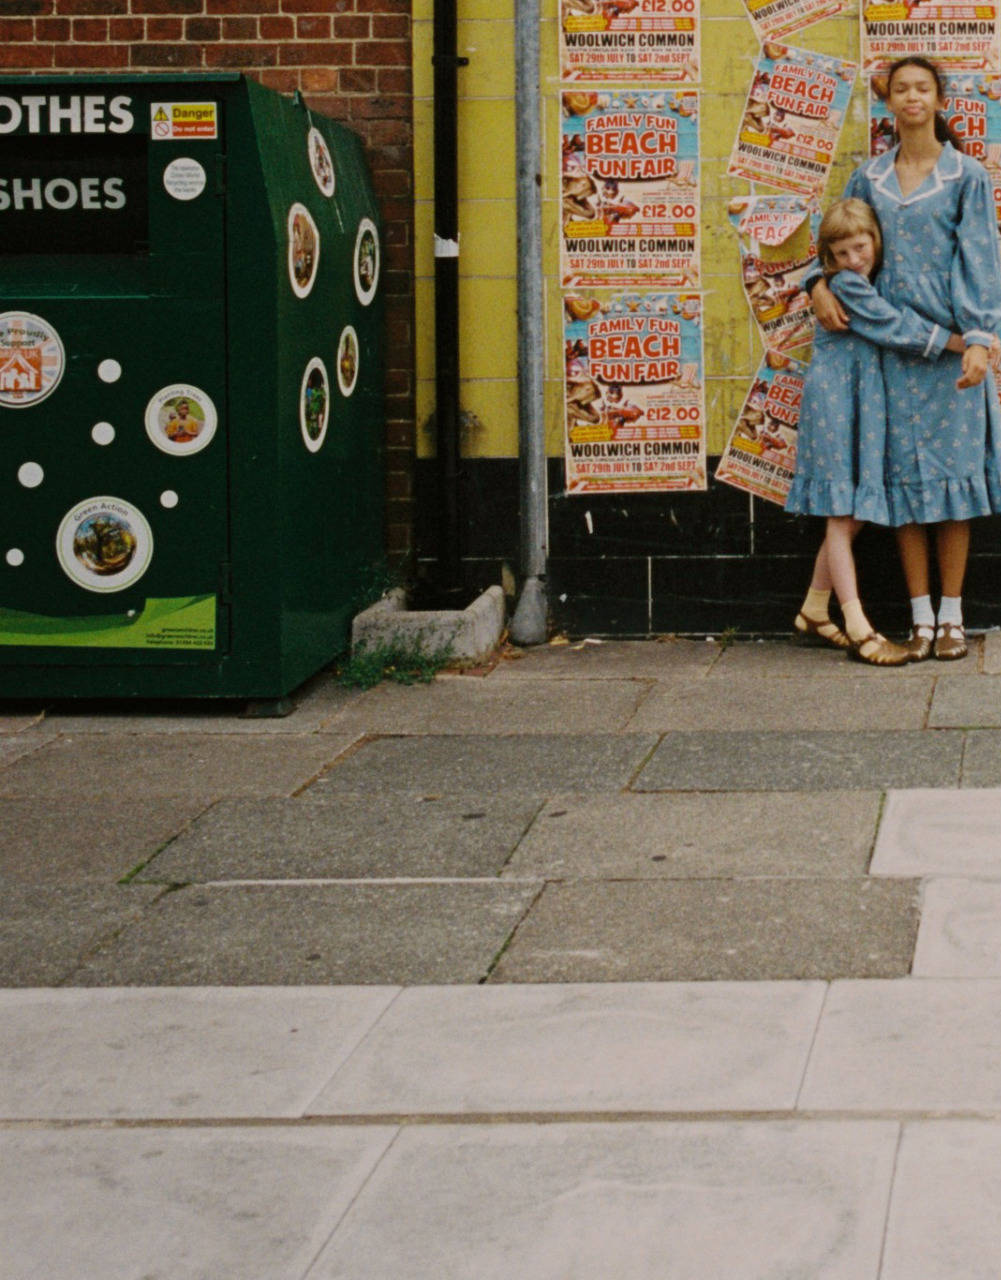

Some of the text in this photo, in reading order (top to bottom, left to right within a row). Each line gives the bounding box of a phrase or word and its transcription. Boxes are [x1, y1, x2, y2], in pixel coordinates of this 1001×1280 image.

[641, 0, 694, 12] £12.00
[866, 21, 995, 35] WOOLWICH COMMON
[565, 33, 694, 46] WOOLWICH COMMON
[870, 41, 990, 51] SAT 29th JULY TO SAT 2nd SEPT
[569, 53, 690, 62] SAT 29th JULY TO SAT 2nd SEPT
[774, 64, 836, 87] FAMILY FUN
[770, 74, 834, 103] BEACH
[956, 99, 985, 113] FUN
[172, 108, 214, 120] Danger
[587, 115, 675, 130] FAMILY FUN
[586, 131, 675, 154] BEACH
[737, 141, 827, 174] WOOLWICH COMMON
[642, 204, 694, 218] £12.00
[746, 225, 793, 240] EAC
[566, 239, 694, 252] WOOLWICH COMMON
[570, 258, 690, 268] SAT 29th JULY TO SAT 2nd SEPT
[589, 318, 678, 334] FAMILY FUN
[7, 327, 50, 342] Proudly
[1, 340, 35, 348] Support
[590, 335, 678, 359] BEACH
[774, 374, 804, 390] FAMIL
[767, 384, 804, 409] BEA
[646, 407, 699, 421] £12.00
[571, 441, 699, 457] WOOLWICH COMMON
[575, 461, 695, 473] SAT 29th JULY TO SAT 2nd SEPT
[728, 446, 795, 481] WOOLWICH COM
[74, 503, 128, 521] Green Action
